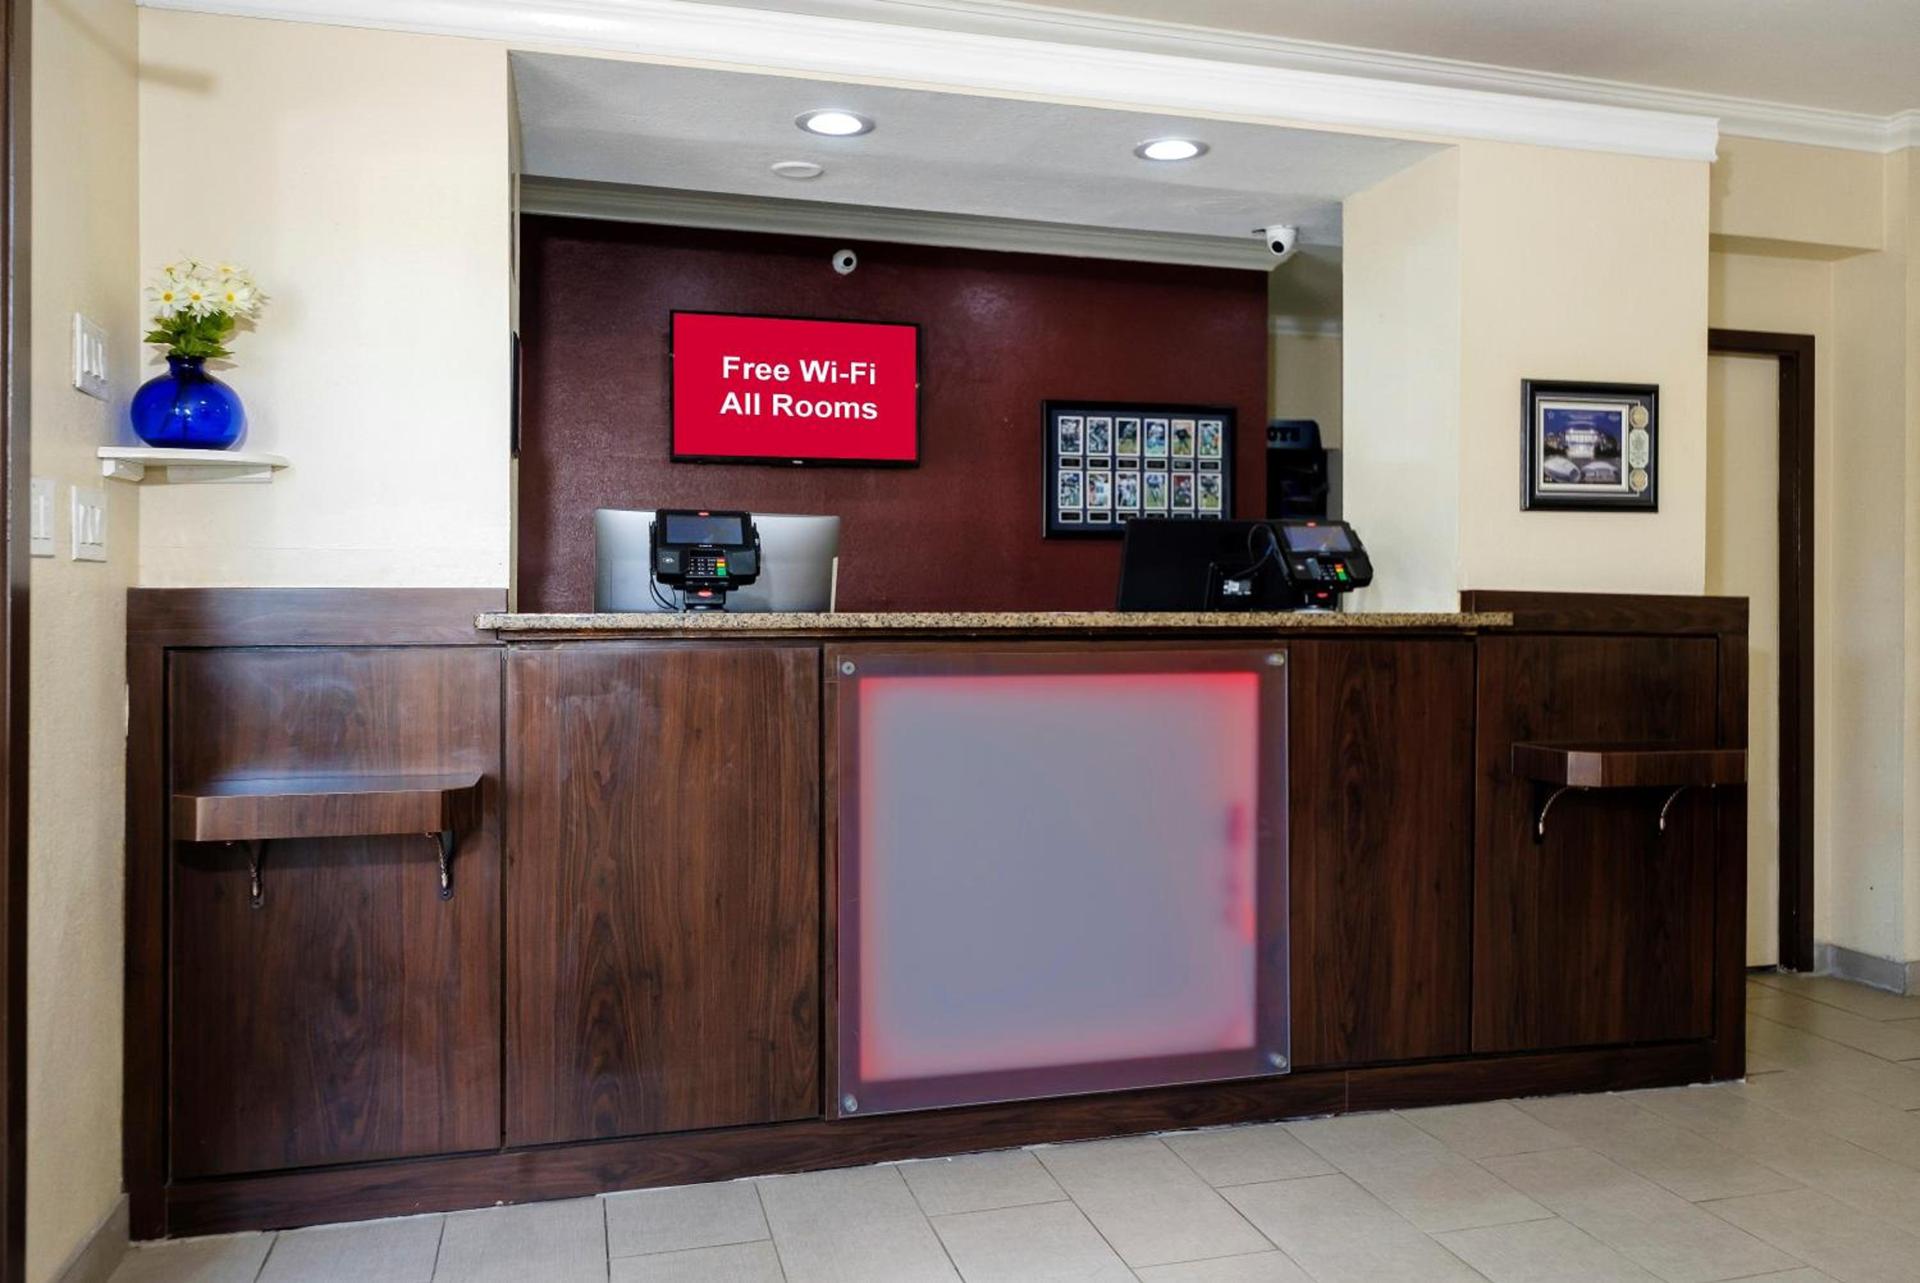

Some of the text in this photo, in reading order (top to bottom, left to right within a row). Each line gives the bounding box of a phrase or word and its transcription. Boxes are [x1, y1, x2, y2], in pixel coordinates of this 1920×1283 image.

[722, 355, 876, 385] Free Wi-Fi
[719, 391, 878, 420] All Rooms
